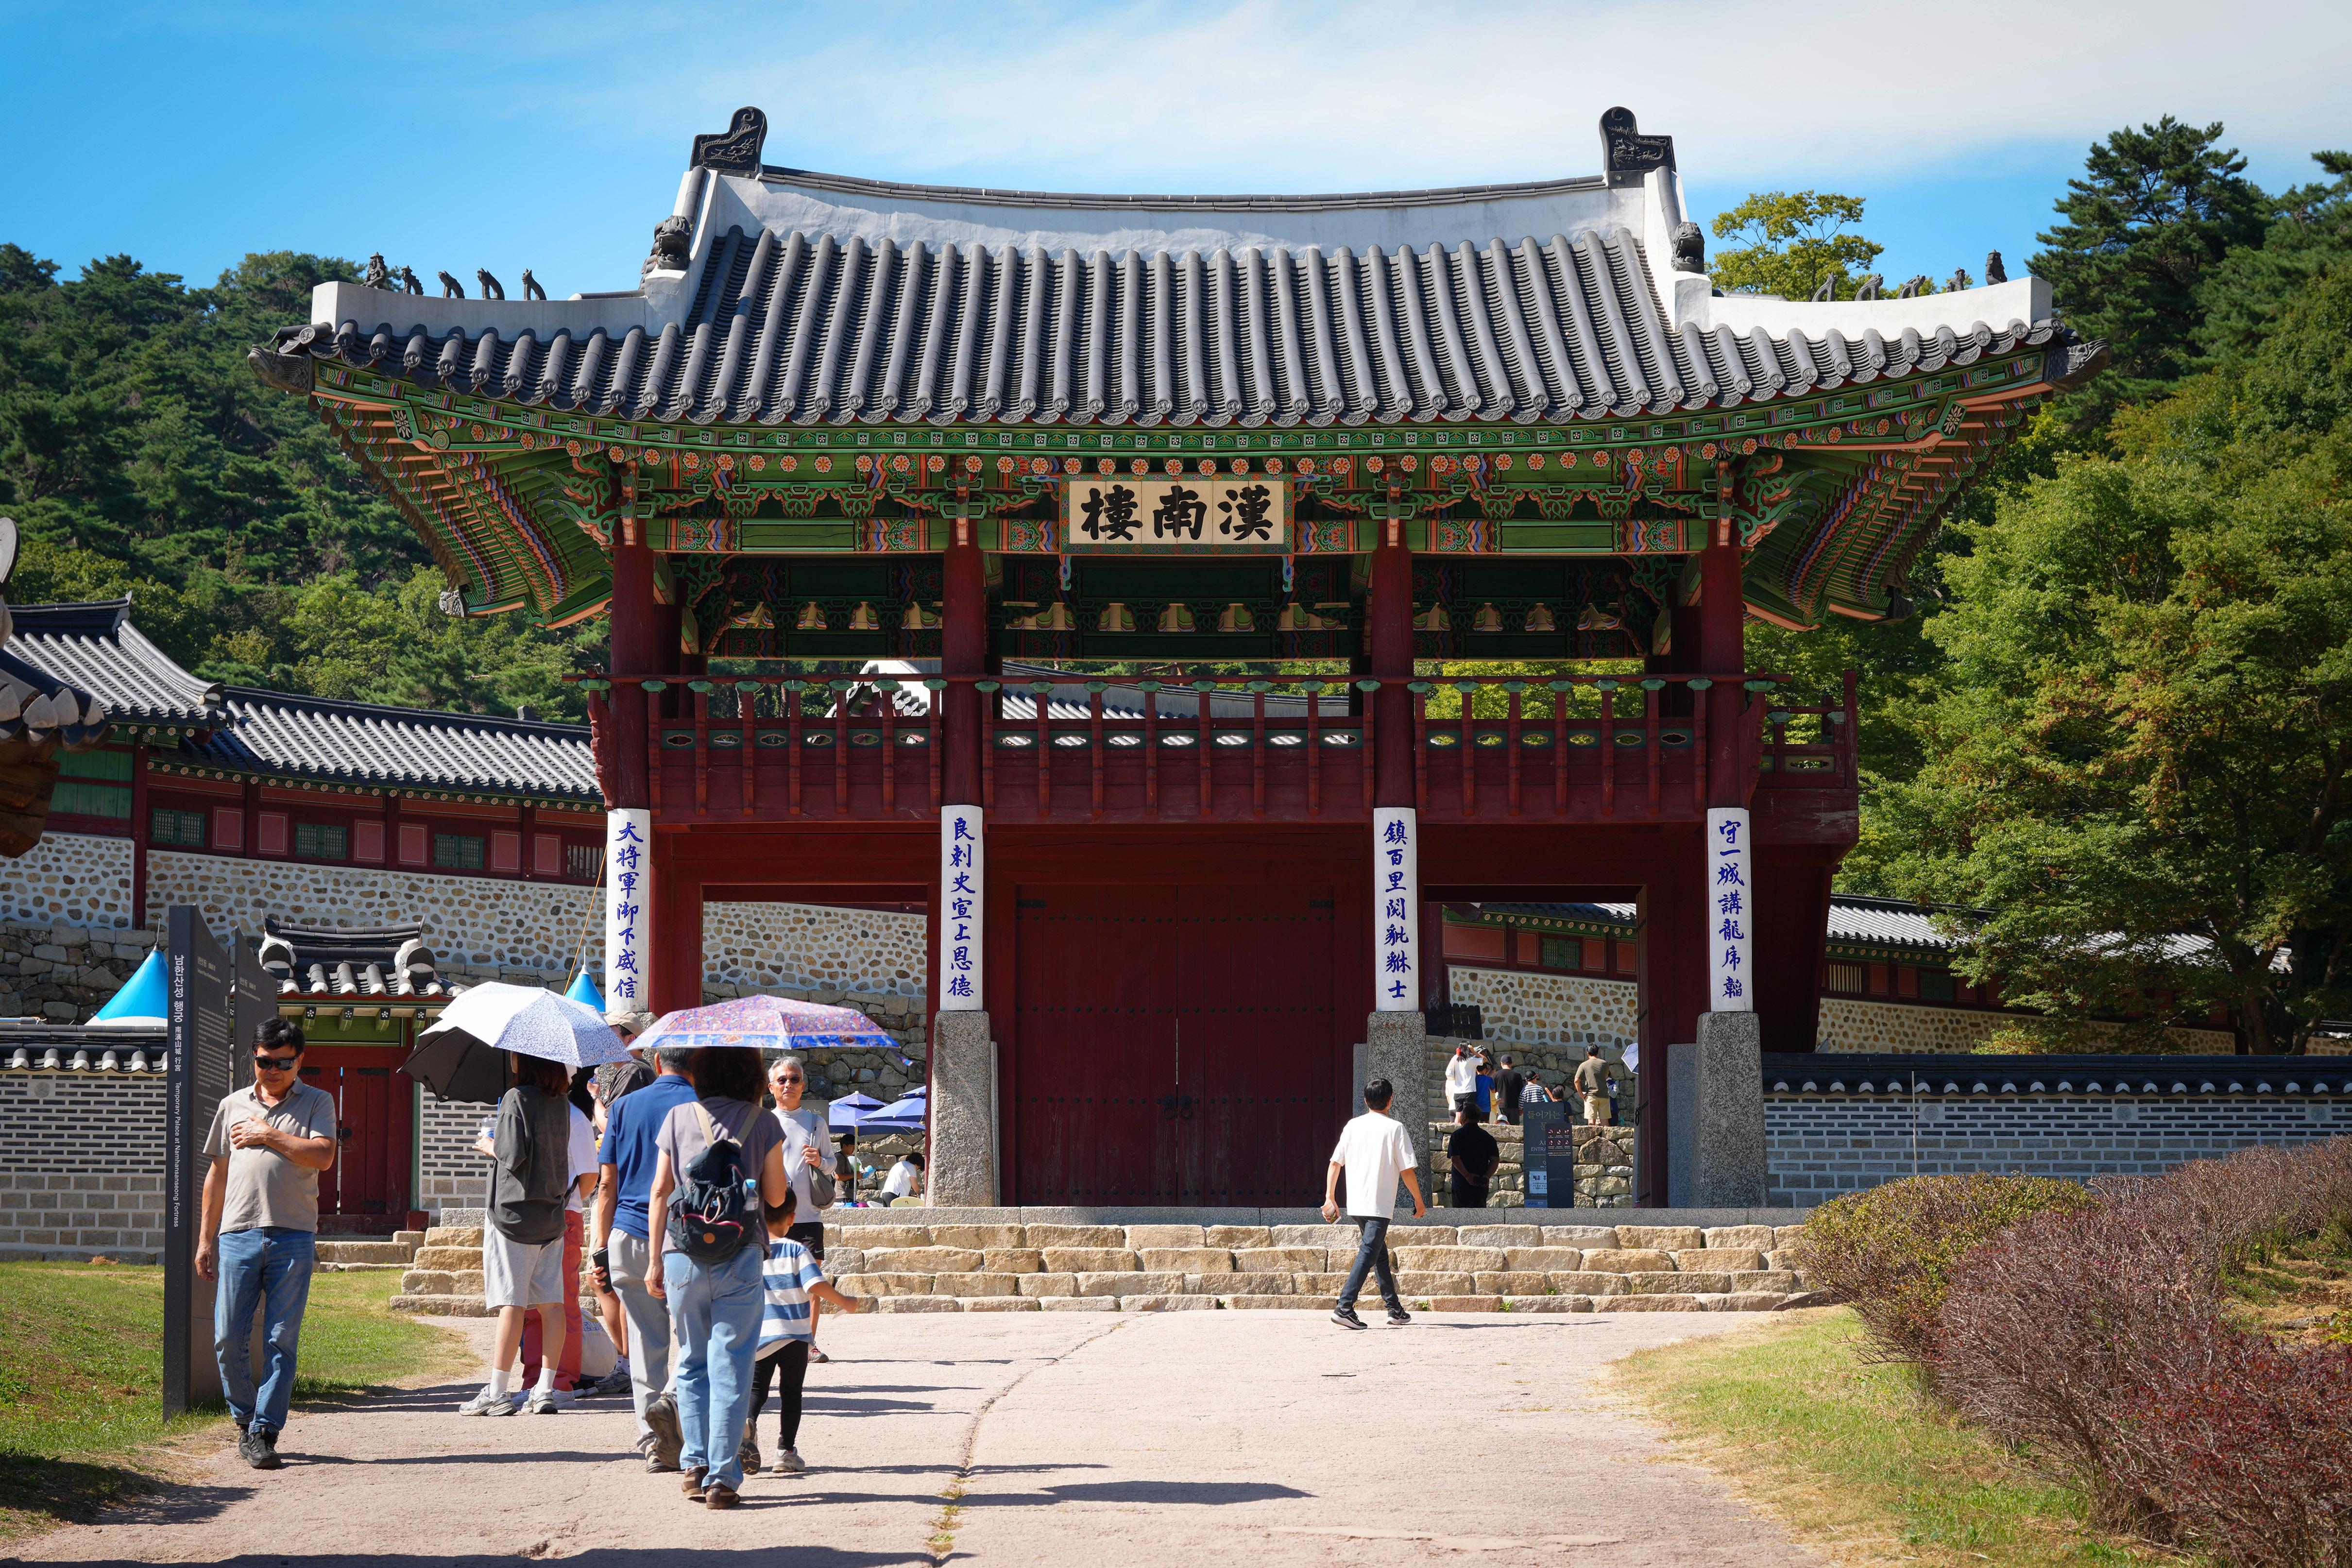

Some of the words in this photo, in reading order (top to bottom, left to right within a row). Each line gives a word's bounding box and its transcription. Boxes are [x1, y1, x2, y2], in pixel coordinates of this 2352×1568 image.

[174, 955, 184, 998] 남한산성
[173, 1001, 183, 1023] 행궁
[175, 1057, 181, 1071] 行宮
[1527, 1110, 1561, 1119] 들어가는
